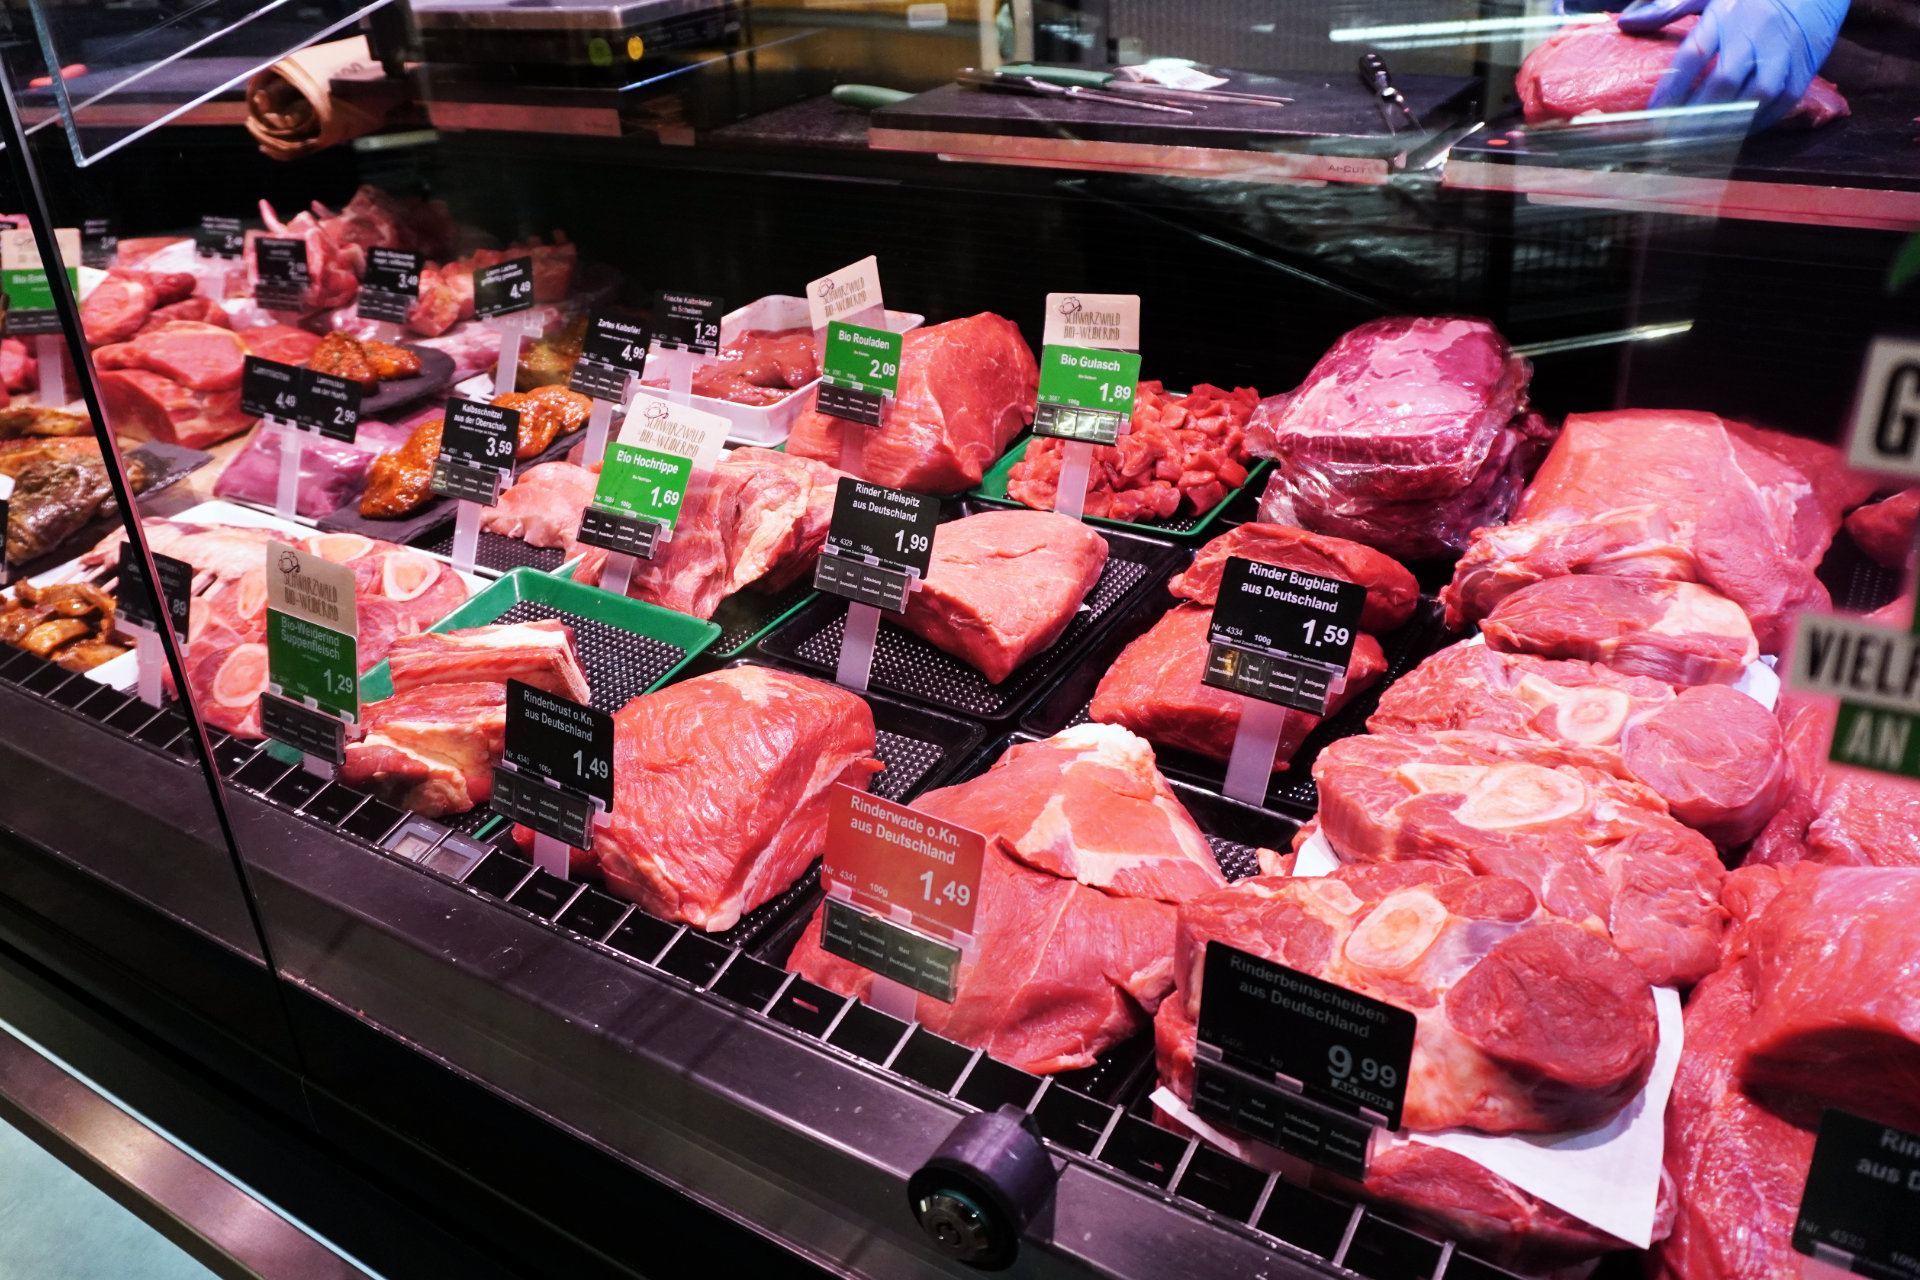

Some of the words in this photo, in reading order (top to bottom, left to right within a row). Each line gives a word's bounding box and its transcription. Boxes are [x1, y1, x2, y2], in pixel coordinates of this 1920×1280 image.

[510, 280, 531, 298] 4.49
[664, 293, 684, 303] Frische
[597, 318, 614, 330] Zartes
[694, 322, 718, 339] 1.29
[838, 330, 852, 342] Bio
[853, 332, 890, 350] Rouladen
[622, 344, 645, 362] 4.99
[1060, 354, 1078, 365] Bio
[1079, 356, 1120, 372] Gulasch
[869, 359, 896, 379] 2.09
[275, 392, 296, 409] 4.49
[1100, 382, 1131, 403] 1.89
[333, 407, 356, 425] 2.99
[462, 404, 502, 419] Kalbsschnitzel
[476, 418, 507, 432] Oberschale
[486, 437, 512, 457] 3.59
[616, 450, 632, 463] Bio
[633, 455, 679, 476] Hochrippe
[651, 486, 680, 508] 1.69
[856, 483, 882, 497] Rinder
[883, 489, 920, 507] Tafelspitz
[852, 500, 866, 510] aus
[868, 502, 917, 522] Deutschland
[840, 538, 852, 546] 4329
[894, 530, 928, 554] 1.99
[1249, 562, 1288, 582] Rinder
[1289, 571, 1340, 594] Bugblatt
[1241, 581, 1262, 595] aus
[1265, 586, 1338, 613] Deutschland
[281, 616, 340, 648] Bio-Weiderind
[1211, 623, 1222, 633] Nr.
[1226, 626, 1243, 636] 4334
[1254, 634, 1272, 646] 100g
[1302, 619, 1349, 647] 1.59
[281, 628, 340, 661] Suppenfleisch
[323, 668, 354, 695] 1.29
[523, 690, 571, 717] Rinderbrust
[573, 711, 594, 727] o.Kn.
[525, 708, 539, 721] aus
[541, 712, 592, 742] Deutschland
[1846, 710, 1911, 767] AN
[505, 749, 514, 760] Nr.
[573, 750, 608, 779] 1.49
[850, 795, 923, 833] Rinderwade
[927, 823, 960, 848] o.Kn.
[850, 817, 873, 835] aus
[875, 823, 956, 865] Deutschland
[823, 863, 836, 877] Nr.
[839, 869, 857, 884] 4341
[869, 882, 889, 897] 100g
[919, 870, 970, 906] 1.49
[1230, 954, 1388, 1024] Rinderbeinscheiben
[1239, 980, 1266, 1000] aus
[1270, 989, 1370, 1038] Deutschland
[1328, 1044, 1397, 1089] 9.99
[1856, 1158, 1901, 1184] aus
